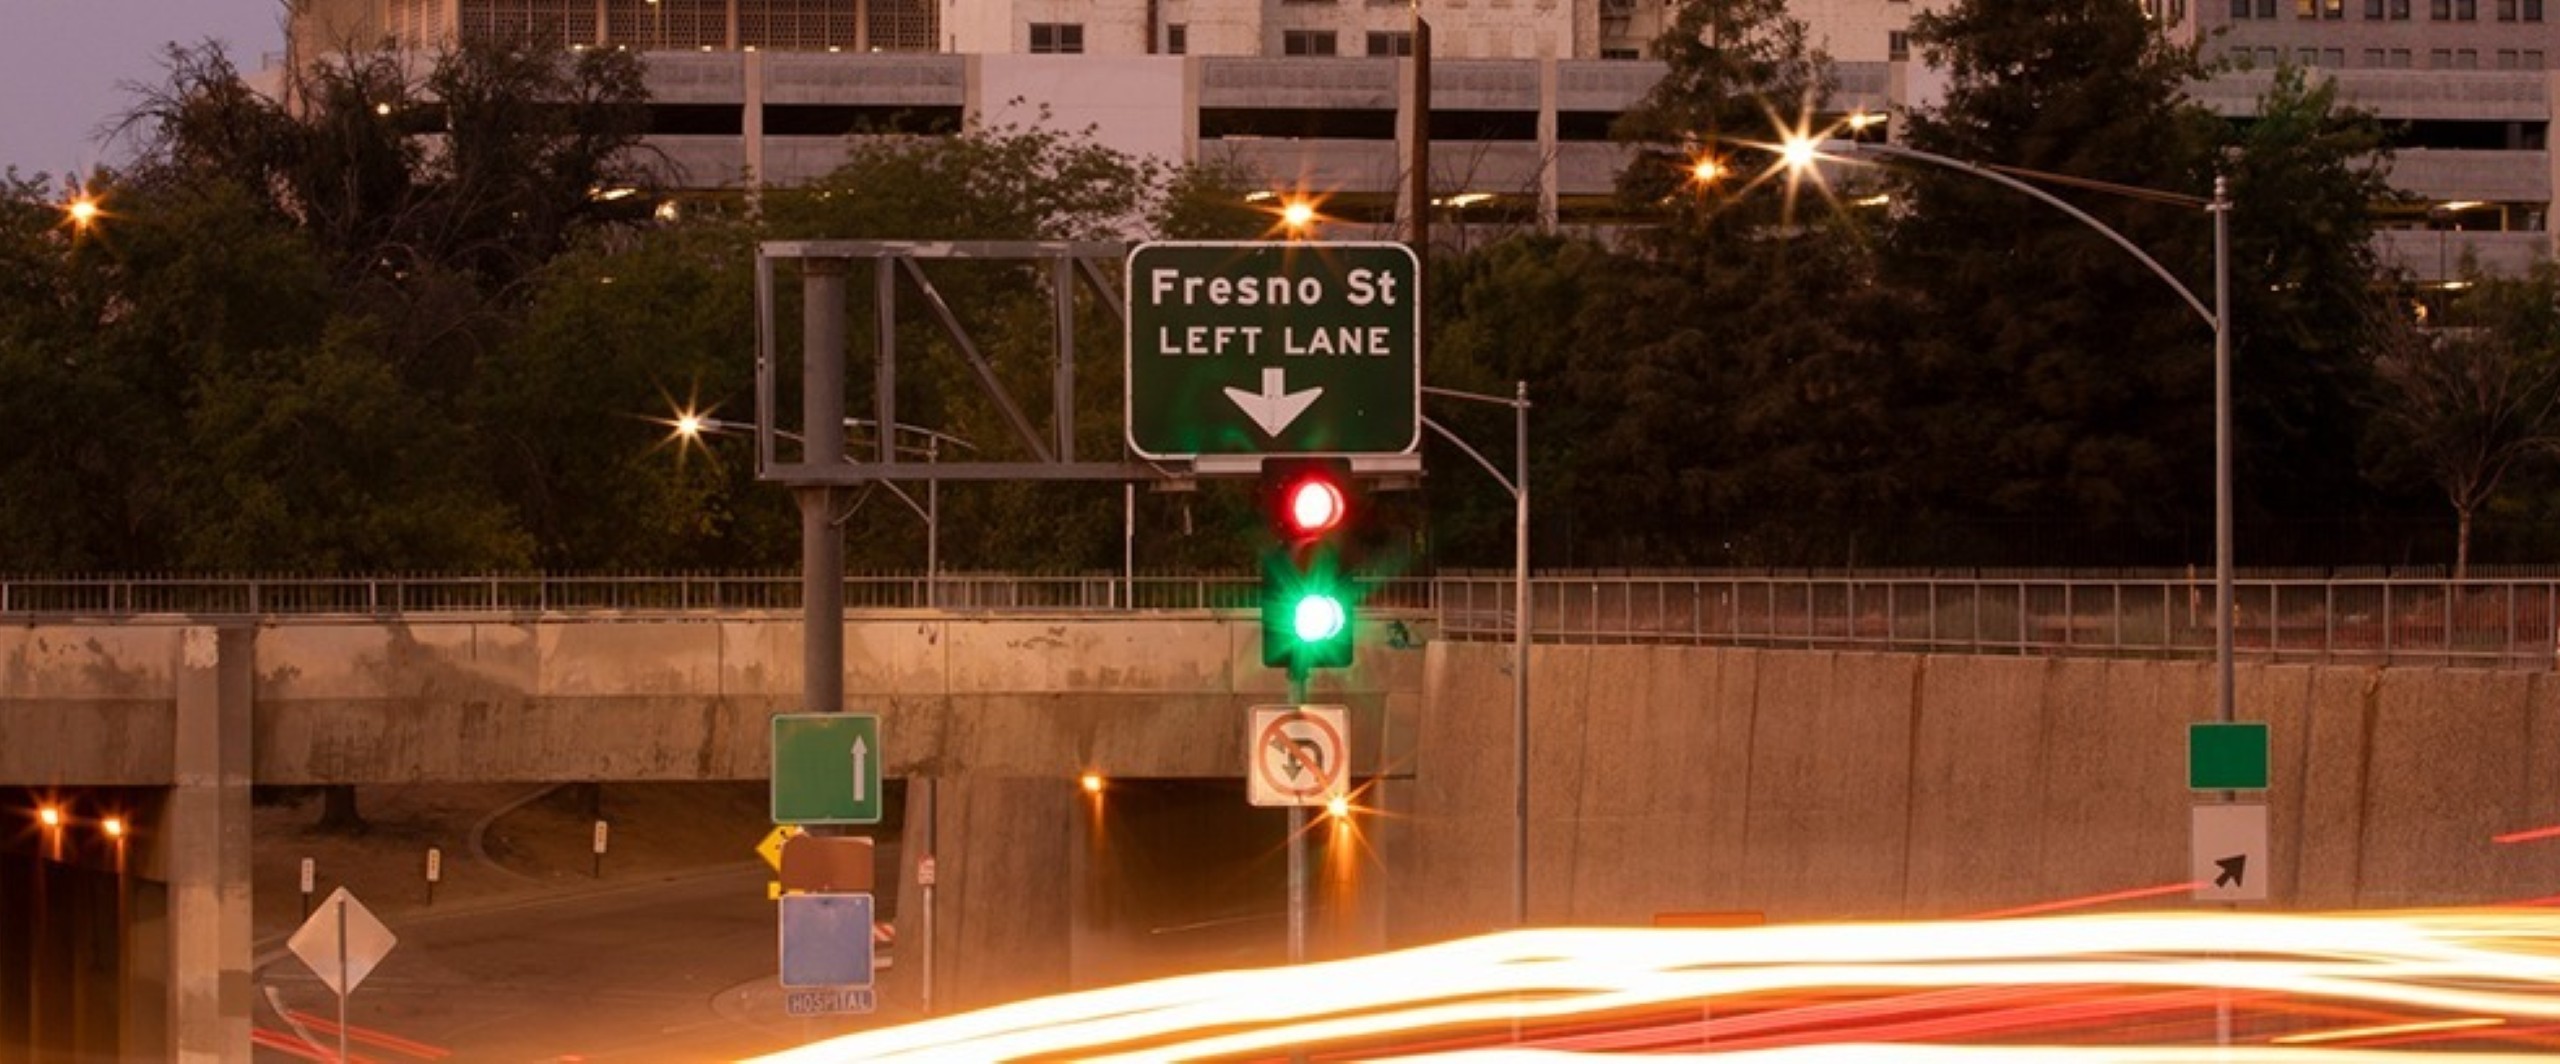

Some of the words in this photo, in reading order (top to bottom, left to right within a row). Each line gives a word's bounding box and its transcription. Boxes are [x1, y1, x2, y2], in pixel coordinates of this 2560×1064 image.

[1152, 268, 1322, 304] Fresno
[1347, 268, 1396, 304] St
[1160, 326, 1262, 354] LEFT
[1284, 326, 1390, 354] LANE
[790, 992, 868, 1012] HOSPITAL
